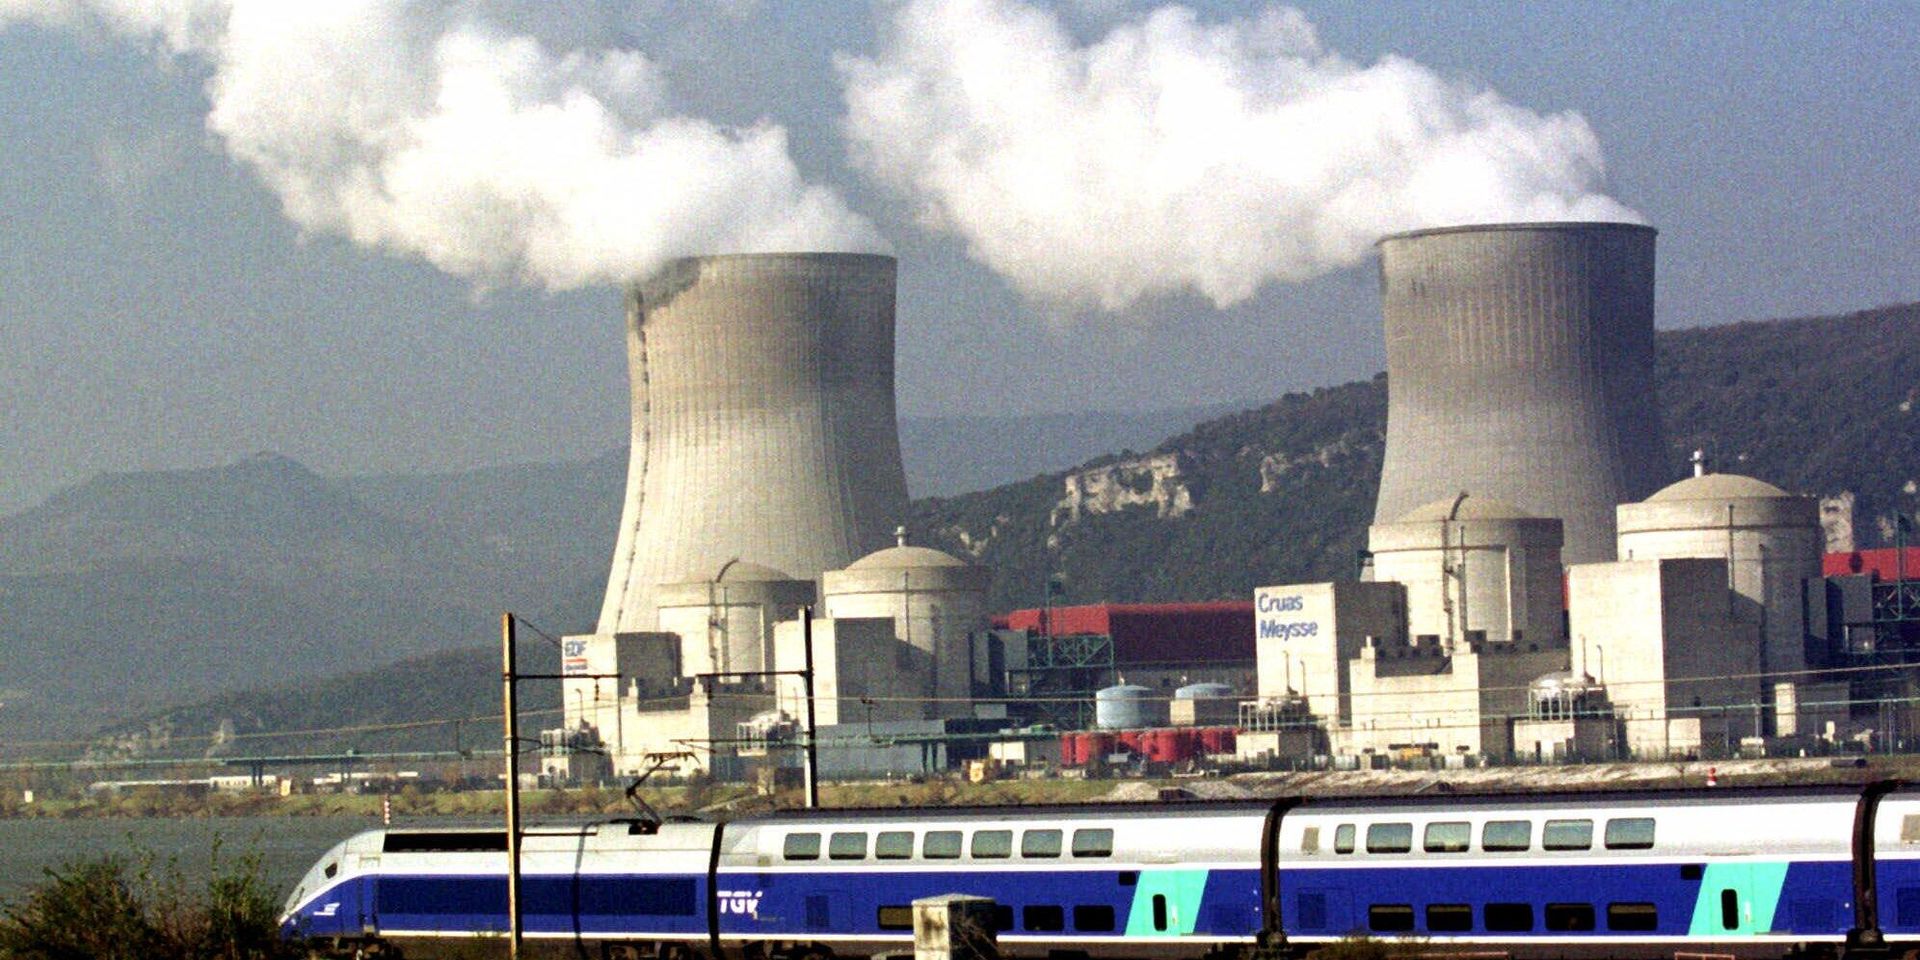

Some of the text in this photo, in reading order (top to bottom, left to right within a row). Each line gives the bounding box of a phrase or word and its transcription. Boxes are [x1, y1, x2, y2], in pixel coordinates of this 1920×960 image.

[1258, 592, 1303, 613] Cruas
[1260, 619, 1318, 641] Meysse
[717, 890, 763, 917] TGV
